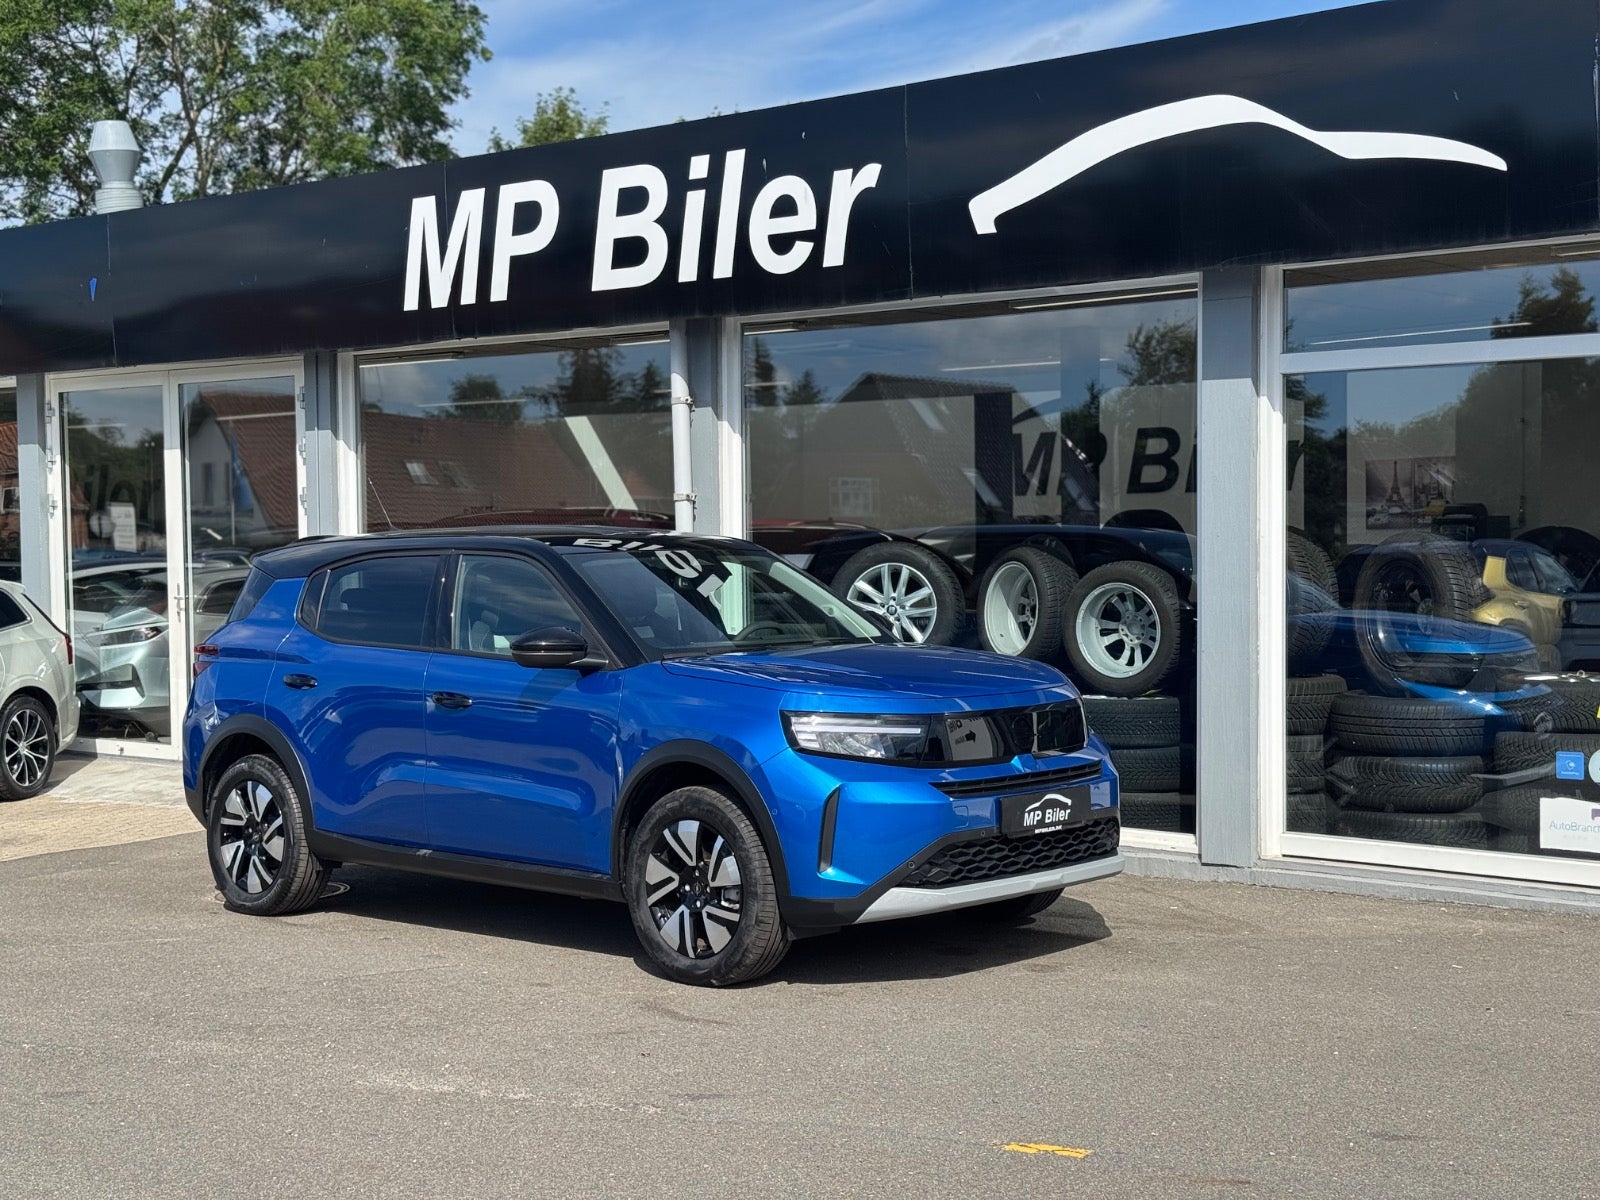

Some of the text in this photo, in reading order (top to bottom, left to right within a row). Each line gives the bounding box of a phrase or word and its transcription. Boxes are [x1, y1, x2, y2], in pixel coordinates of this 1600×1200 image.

[403, 148, 882, 312] MP Biler
[1023, 807, 1071, 827] MP Biler
